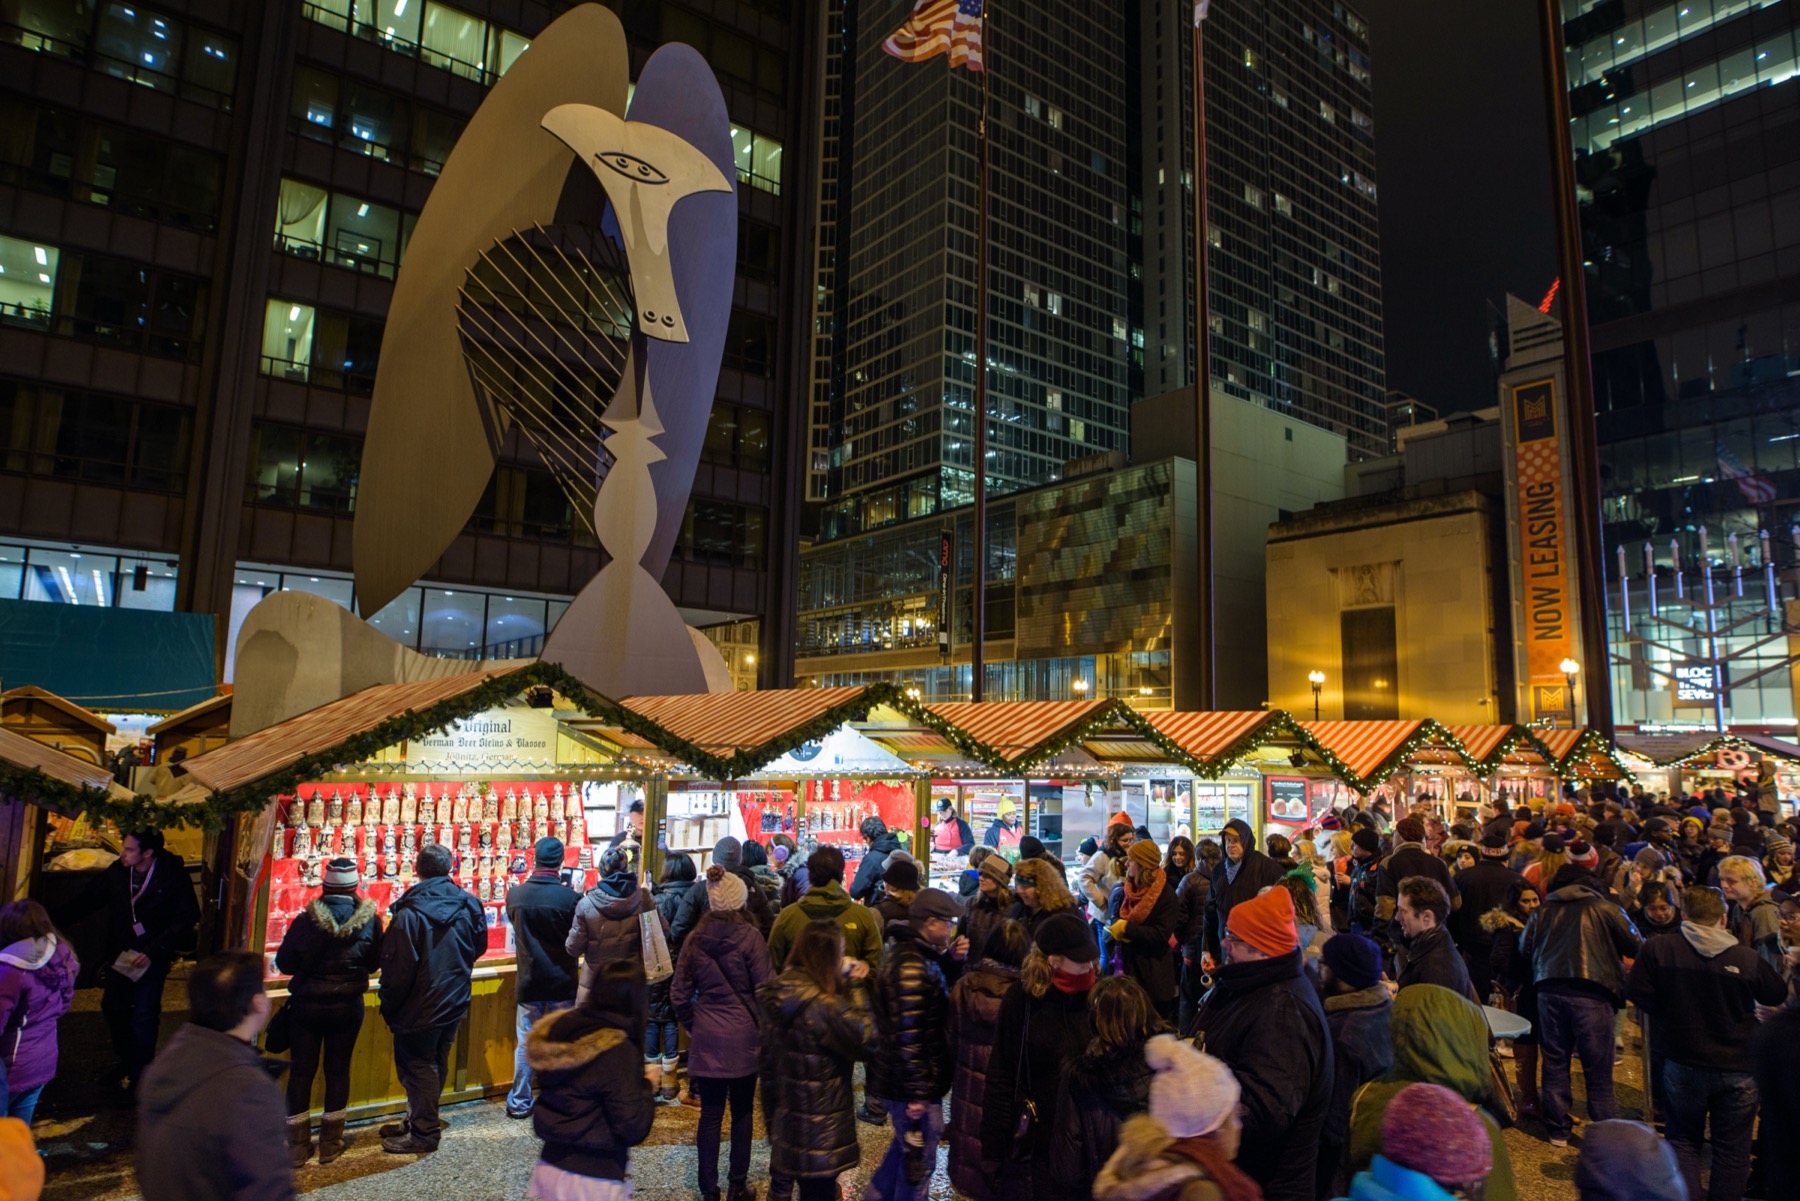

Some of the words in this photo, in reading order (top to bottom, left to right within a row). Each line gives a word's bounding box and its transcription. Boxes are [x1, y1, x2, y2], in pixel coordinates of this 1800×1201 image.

[1526, 481, 1559, 578] LEASING
[1532, 587, 1563, 640] NOW
[1676, 667, 1713, 678] BLOC
[458, 738, 476, 748] Beer
[479, 738, 504, 748] Steins
[506, 740, 512, 748] &
[516, 738, 546, 748] Glasses
